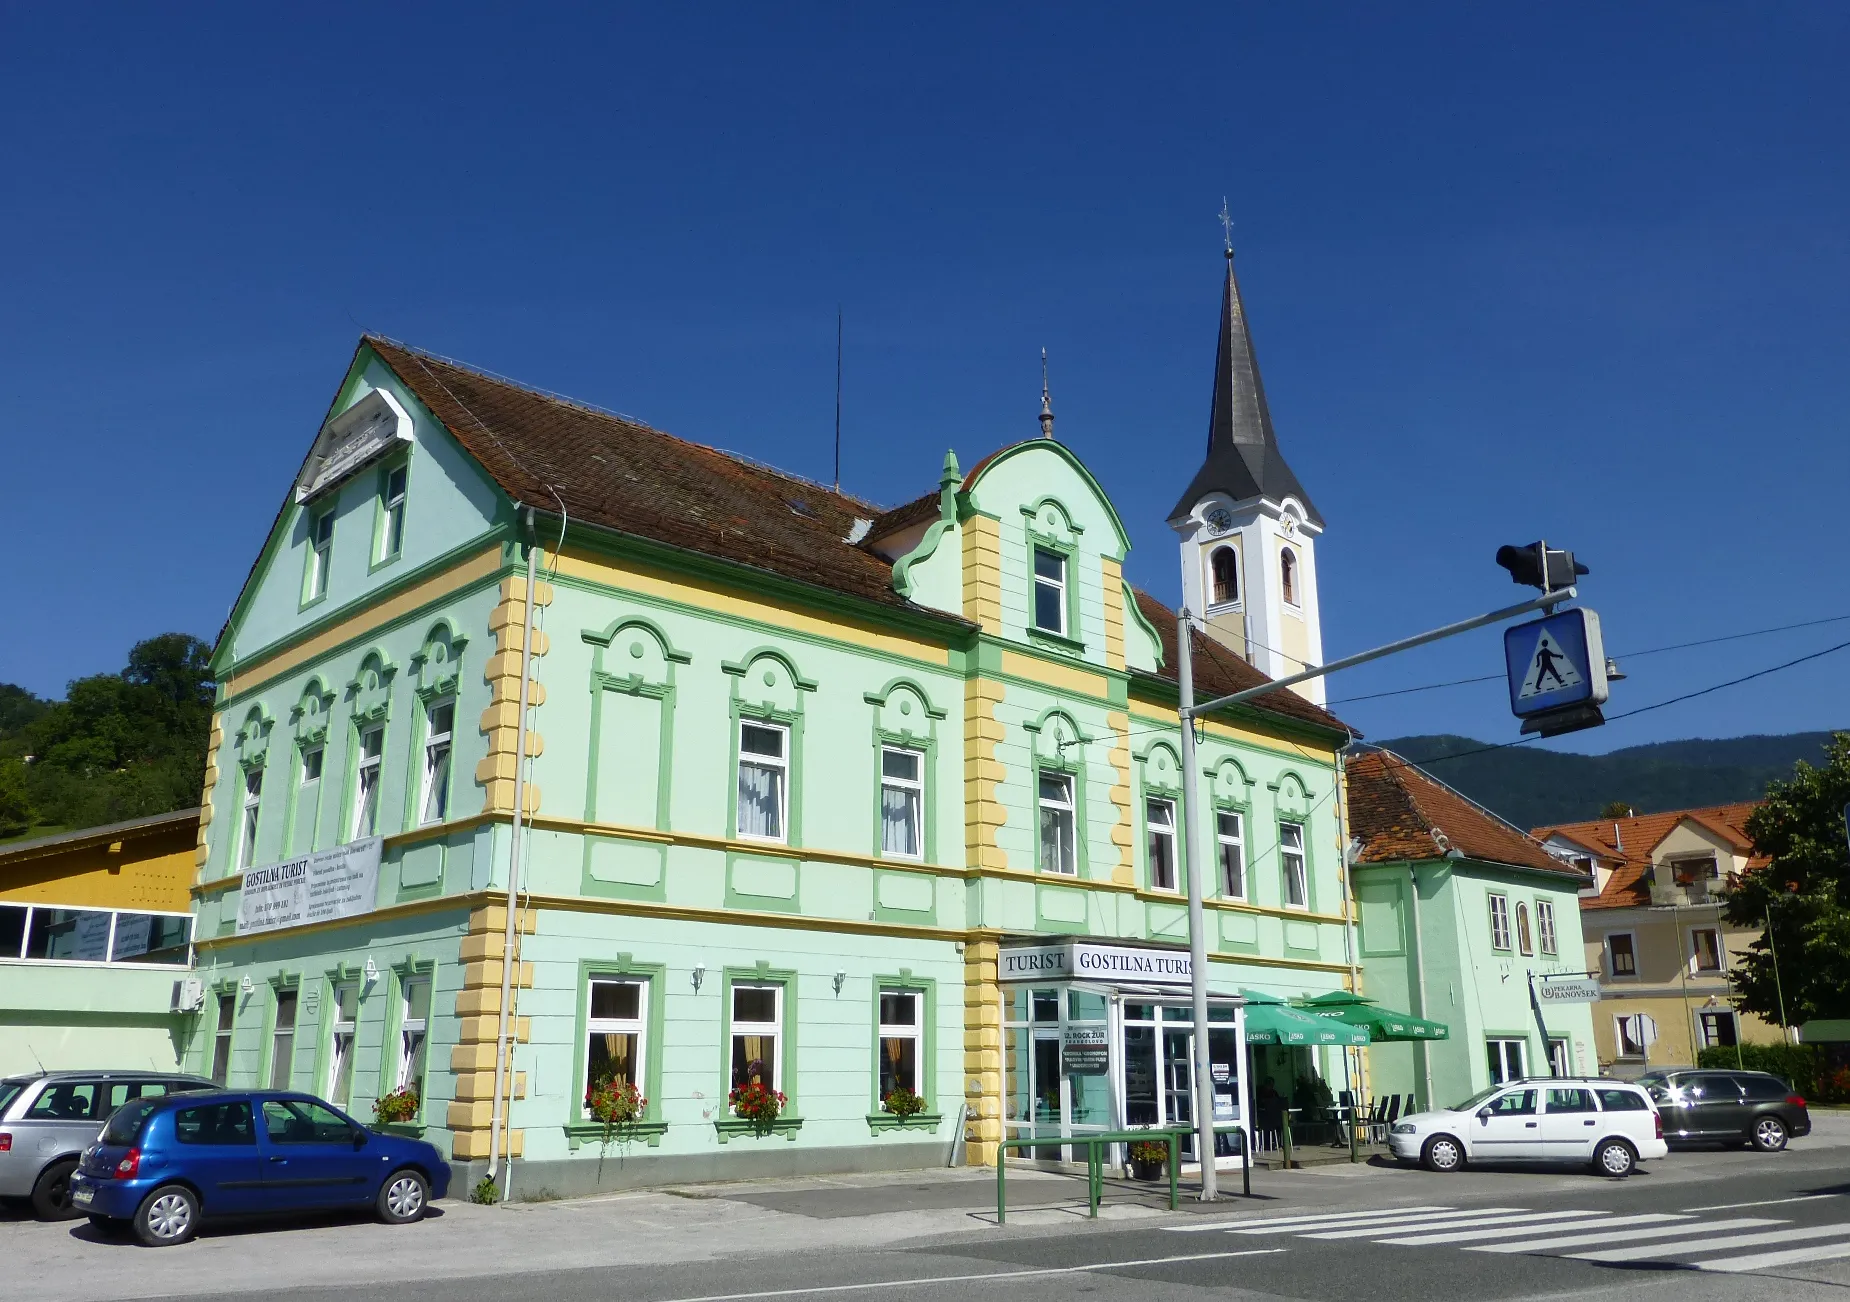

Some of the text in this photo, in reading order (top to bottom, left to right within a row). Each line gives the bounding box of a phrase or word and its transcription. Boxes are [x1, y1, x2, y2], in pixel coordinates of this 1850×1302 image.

[246, 867, 280, 888] GOSTILNA
[281, 860, 308, 880] TURIST
[1005, 952, 1065, 972] TURIST
[1079, 952, 1192, 975] GOSTILNA TURIS
[1554, 989, 1598, 999] BANOVŠEK
[1091, 1030, 1105, 1039] ŽUR
